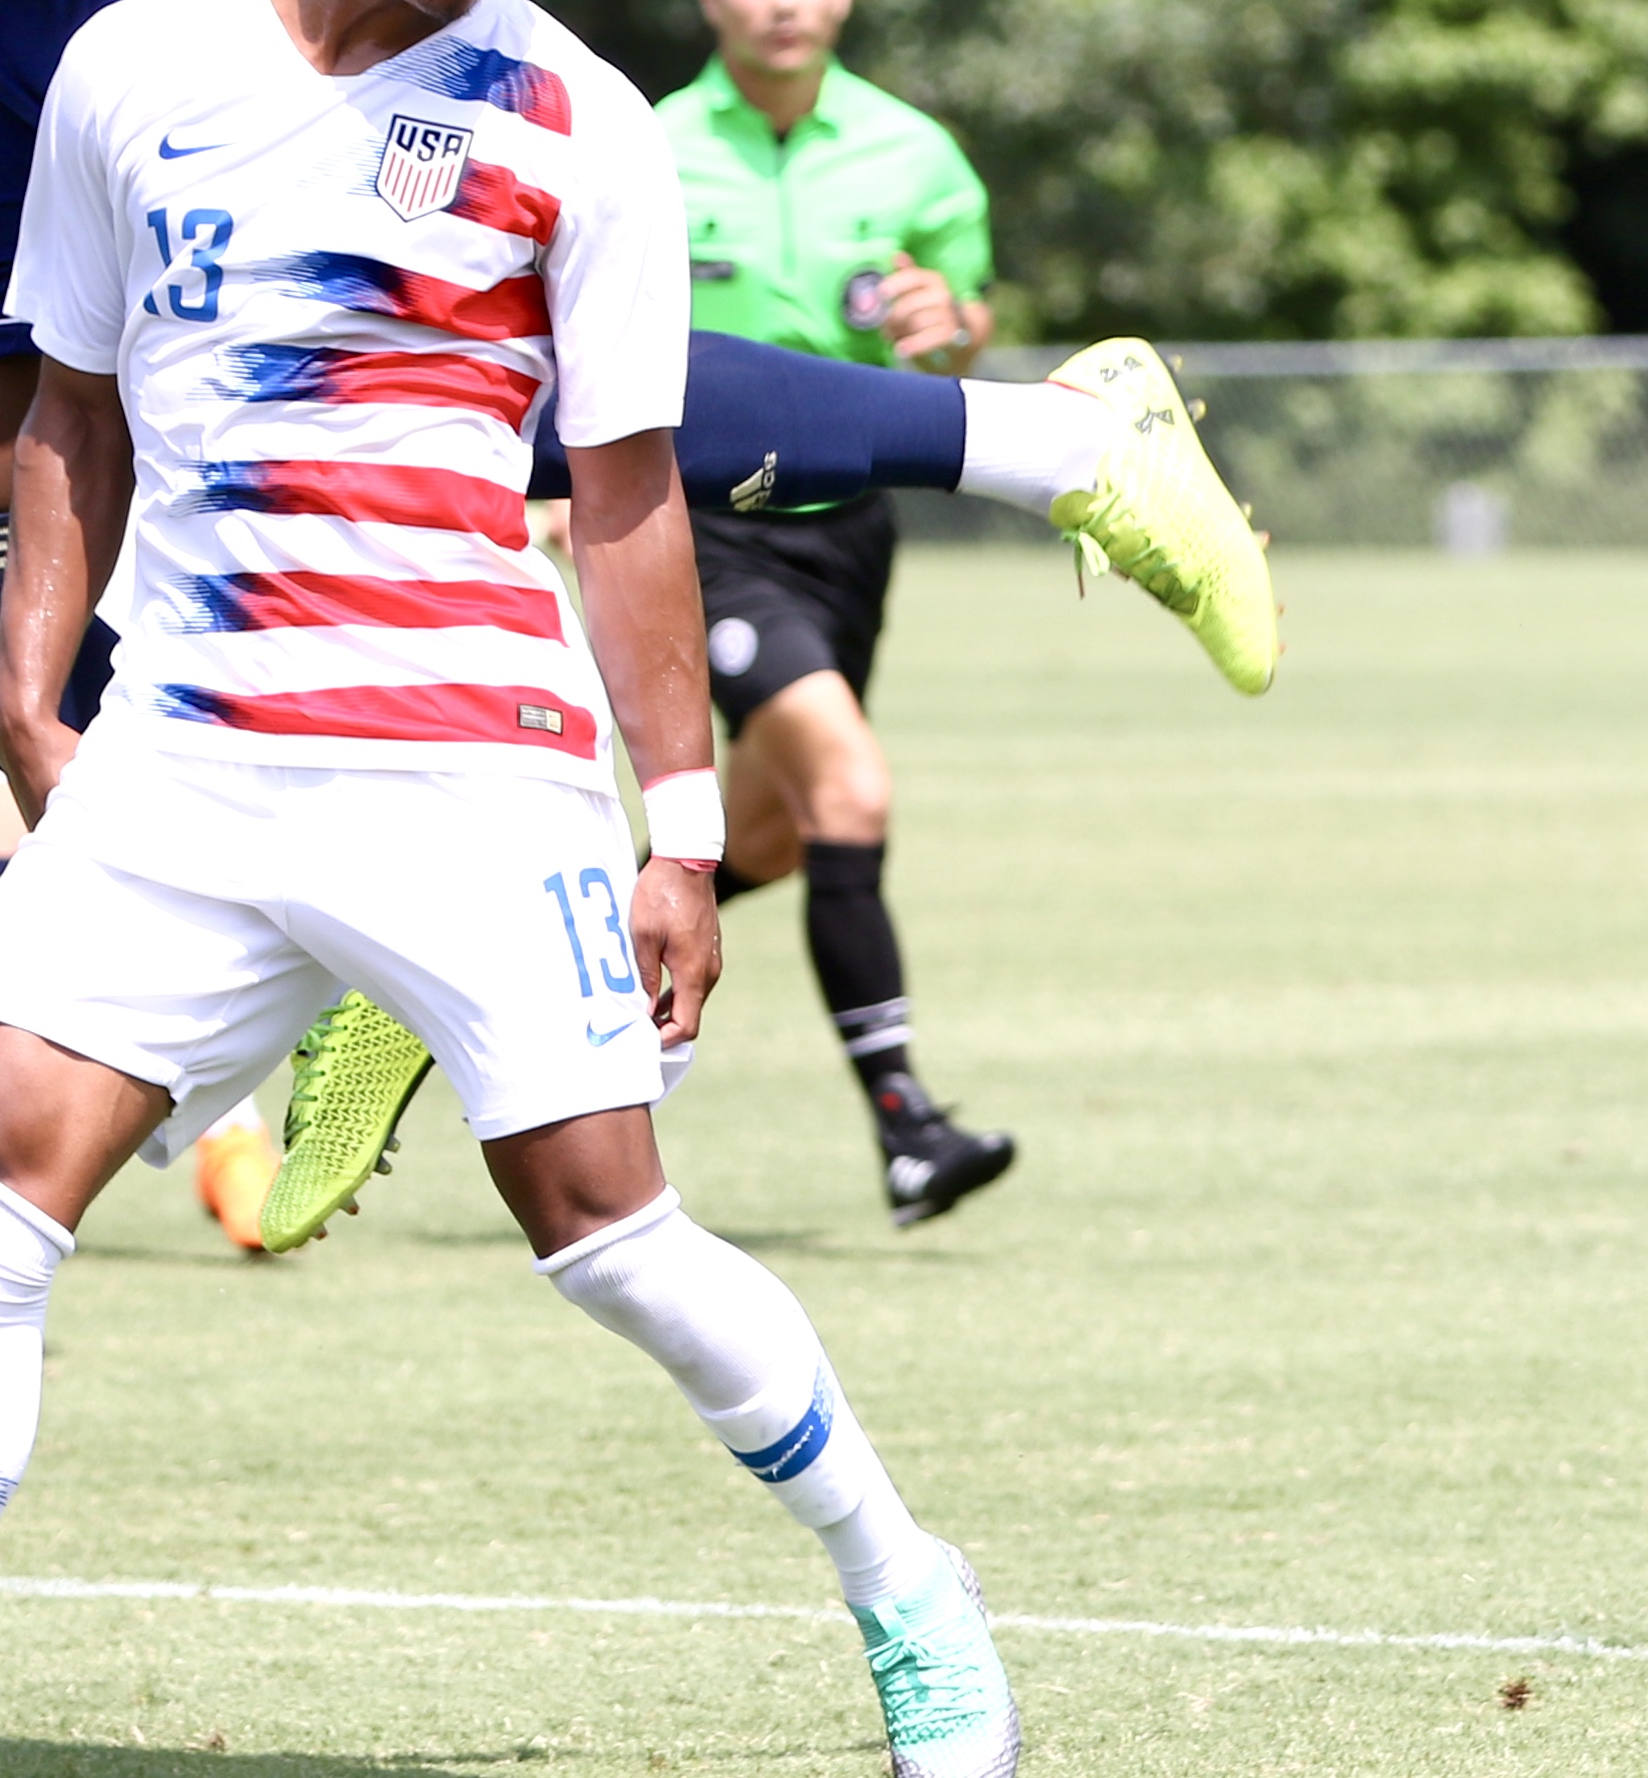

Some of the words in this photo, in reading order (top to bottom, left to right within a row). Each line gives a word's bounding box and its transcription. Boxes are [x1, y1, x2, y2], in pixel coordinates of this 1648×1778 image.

[395, 122, 464, 162] USA
[143, 207, 234, 323] 13
[543, 867, 636, 998] 13
